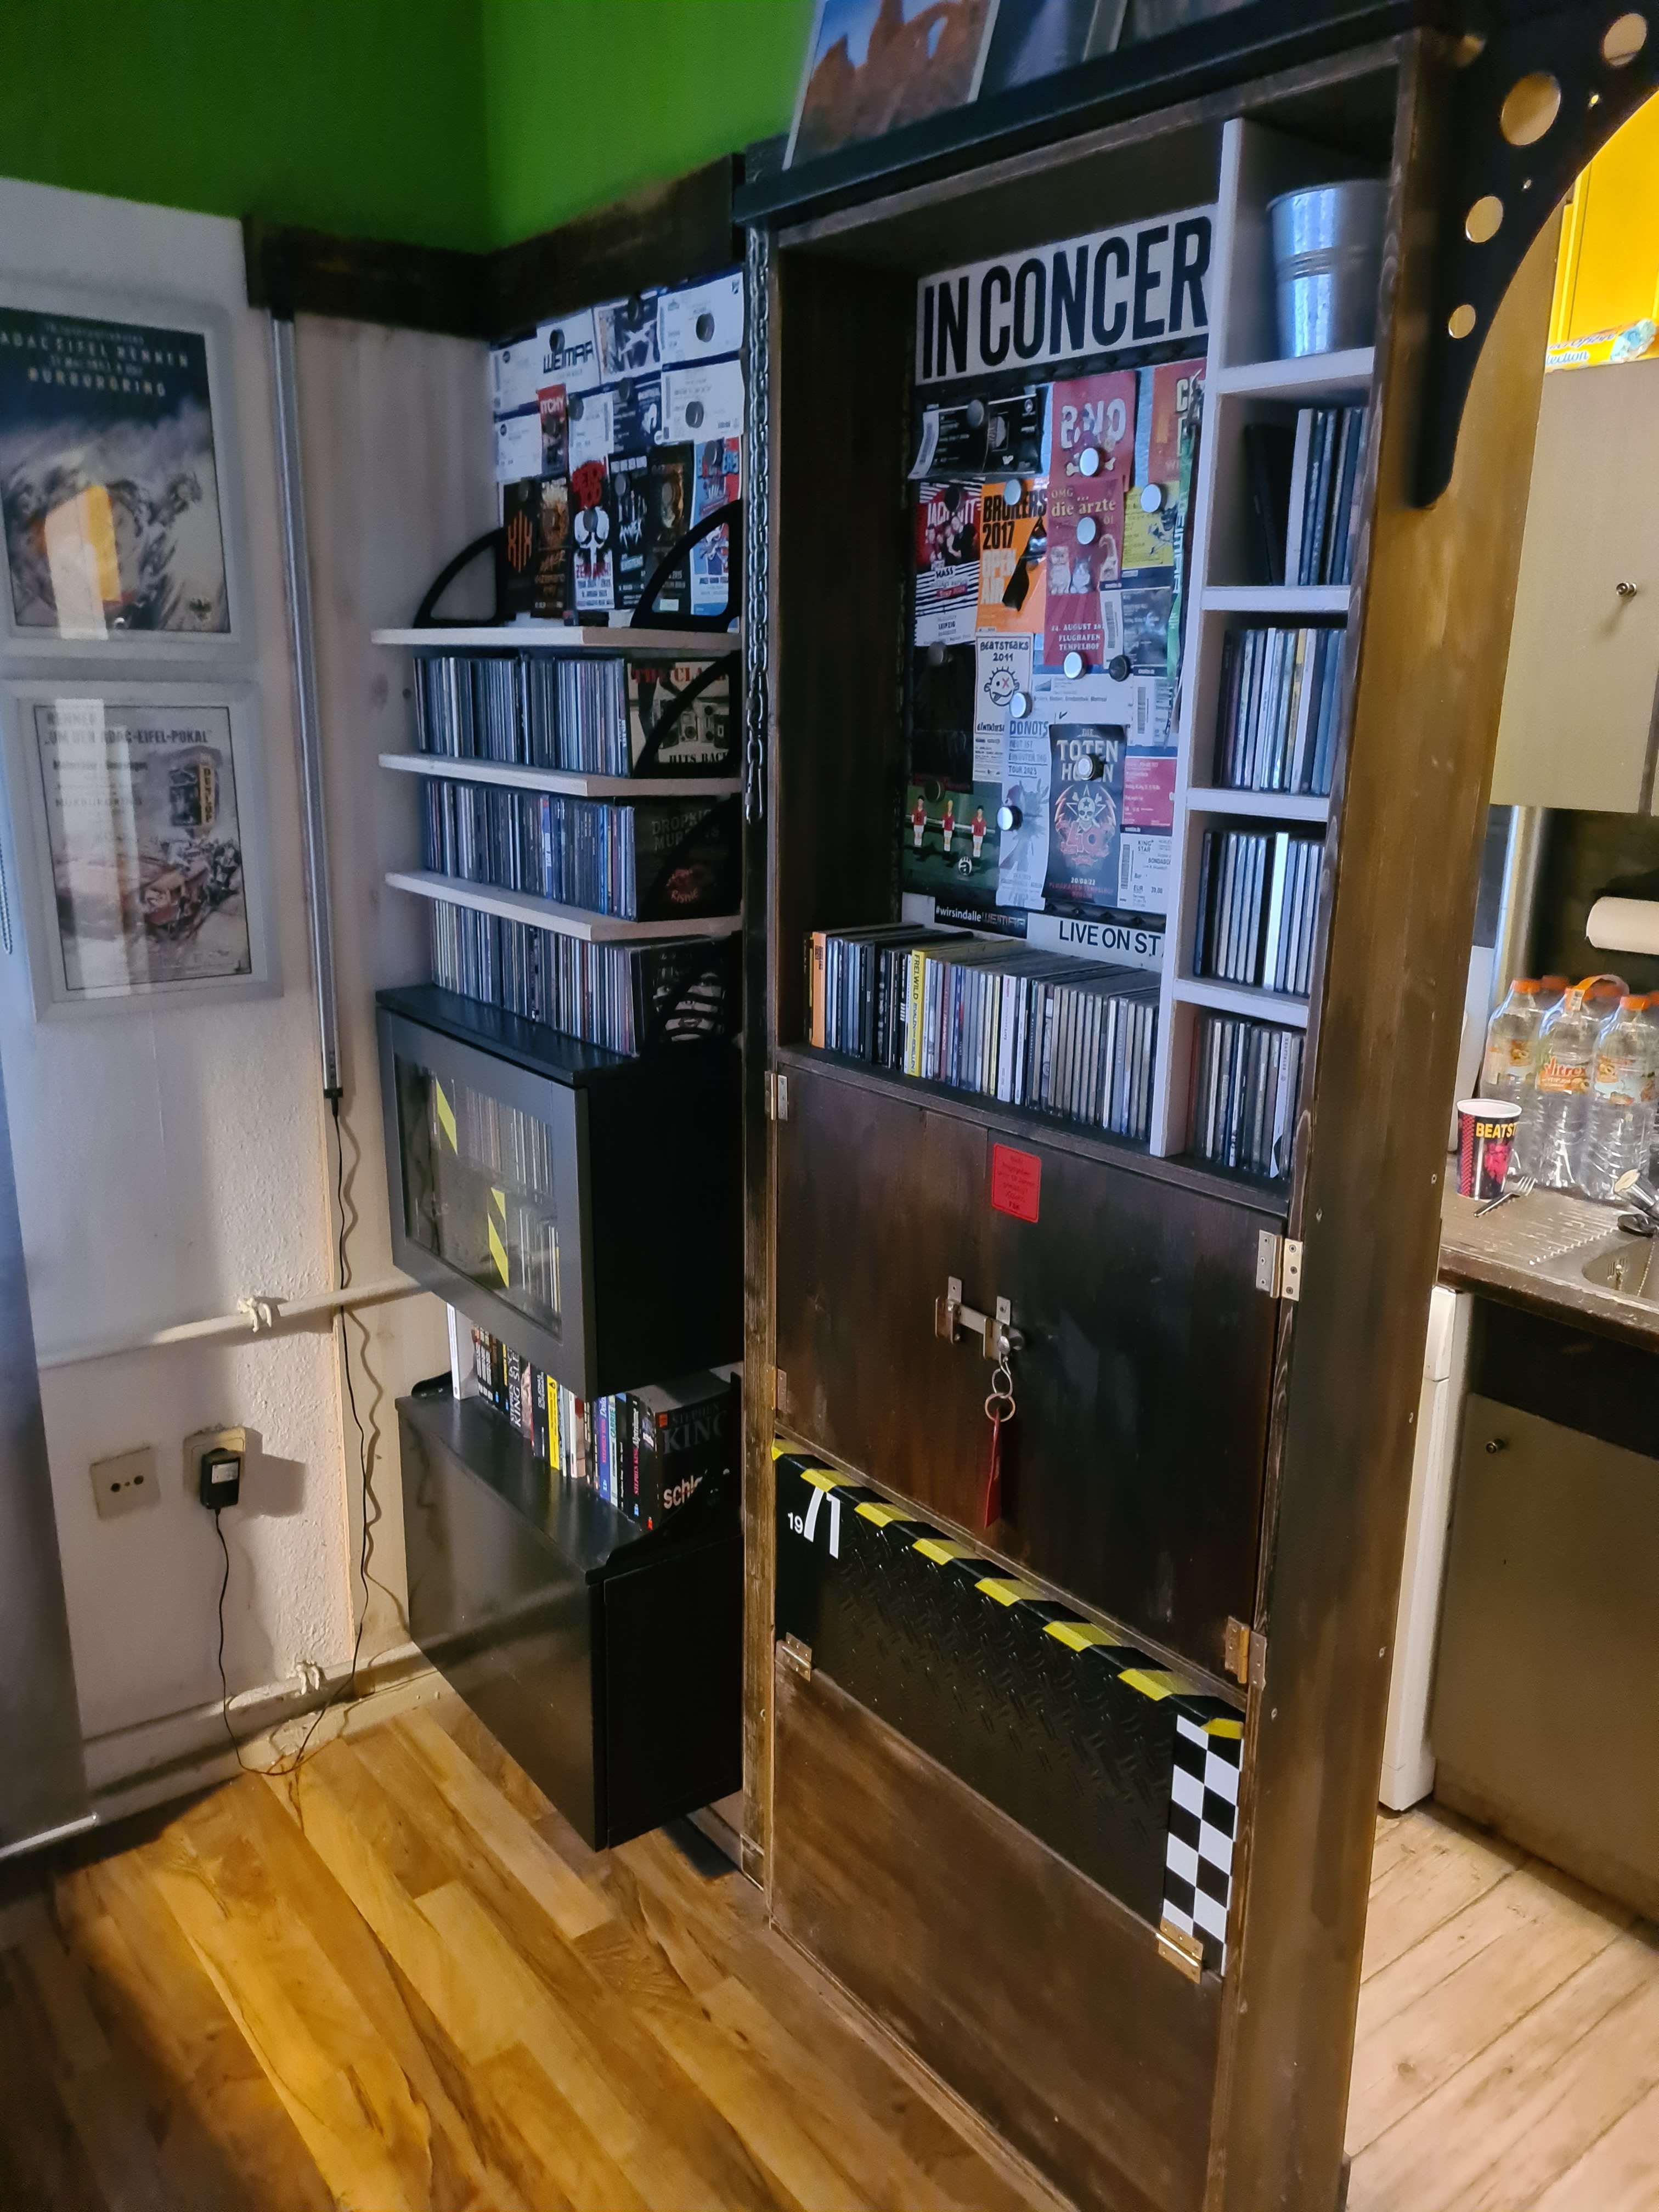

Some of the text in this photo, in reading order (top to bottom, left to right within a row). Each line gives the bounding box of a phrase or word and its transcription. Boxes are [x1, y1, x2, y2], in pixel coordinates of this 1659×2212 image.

[923, 275, 969, 379] IN
[1051, 502, 1074, 517] die
[983, 521, 1015, 550] 2017
[938, 620, 956, 630] LEIPZIG
[1063, 623, 1092, 631] AUGUST
[1058, 633, 1101, 642] FLUGHAFEN
[1059, 643, 1100, 651] TEMPELHOF
[1009, 720, 1049, 737] DONOTS
[1056, 739, 1119, 763] TOTEN
[1062, 762, 1114, 783] HON
[1059, 920, 1164, 958] LIVE ON ST
[512, 1385, 522, 1427] KING
[787, 1512, 804, 1534] 19
